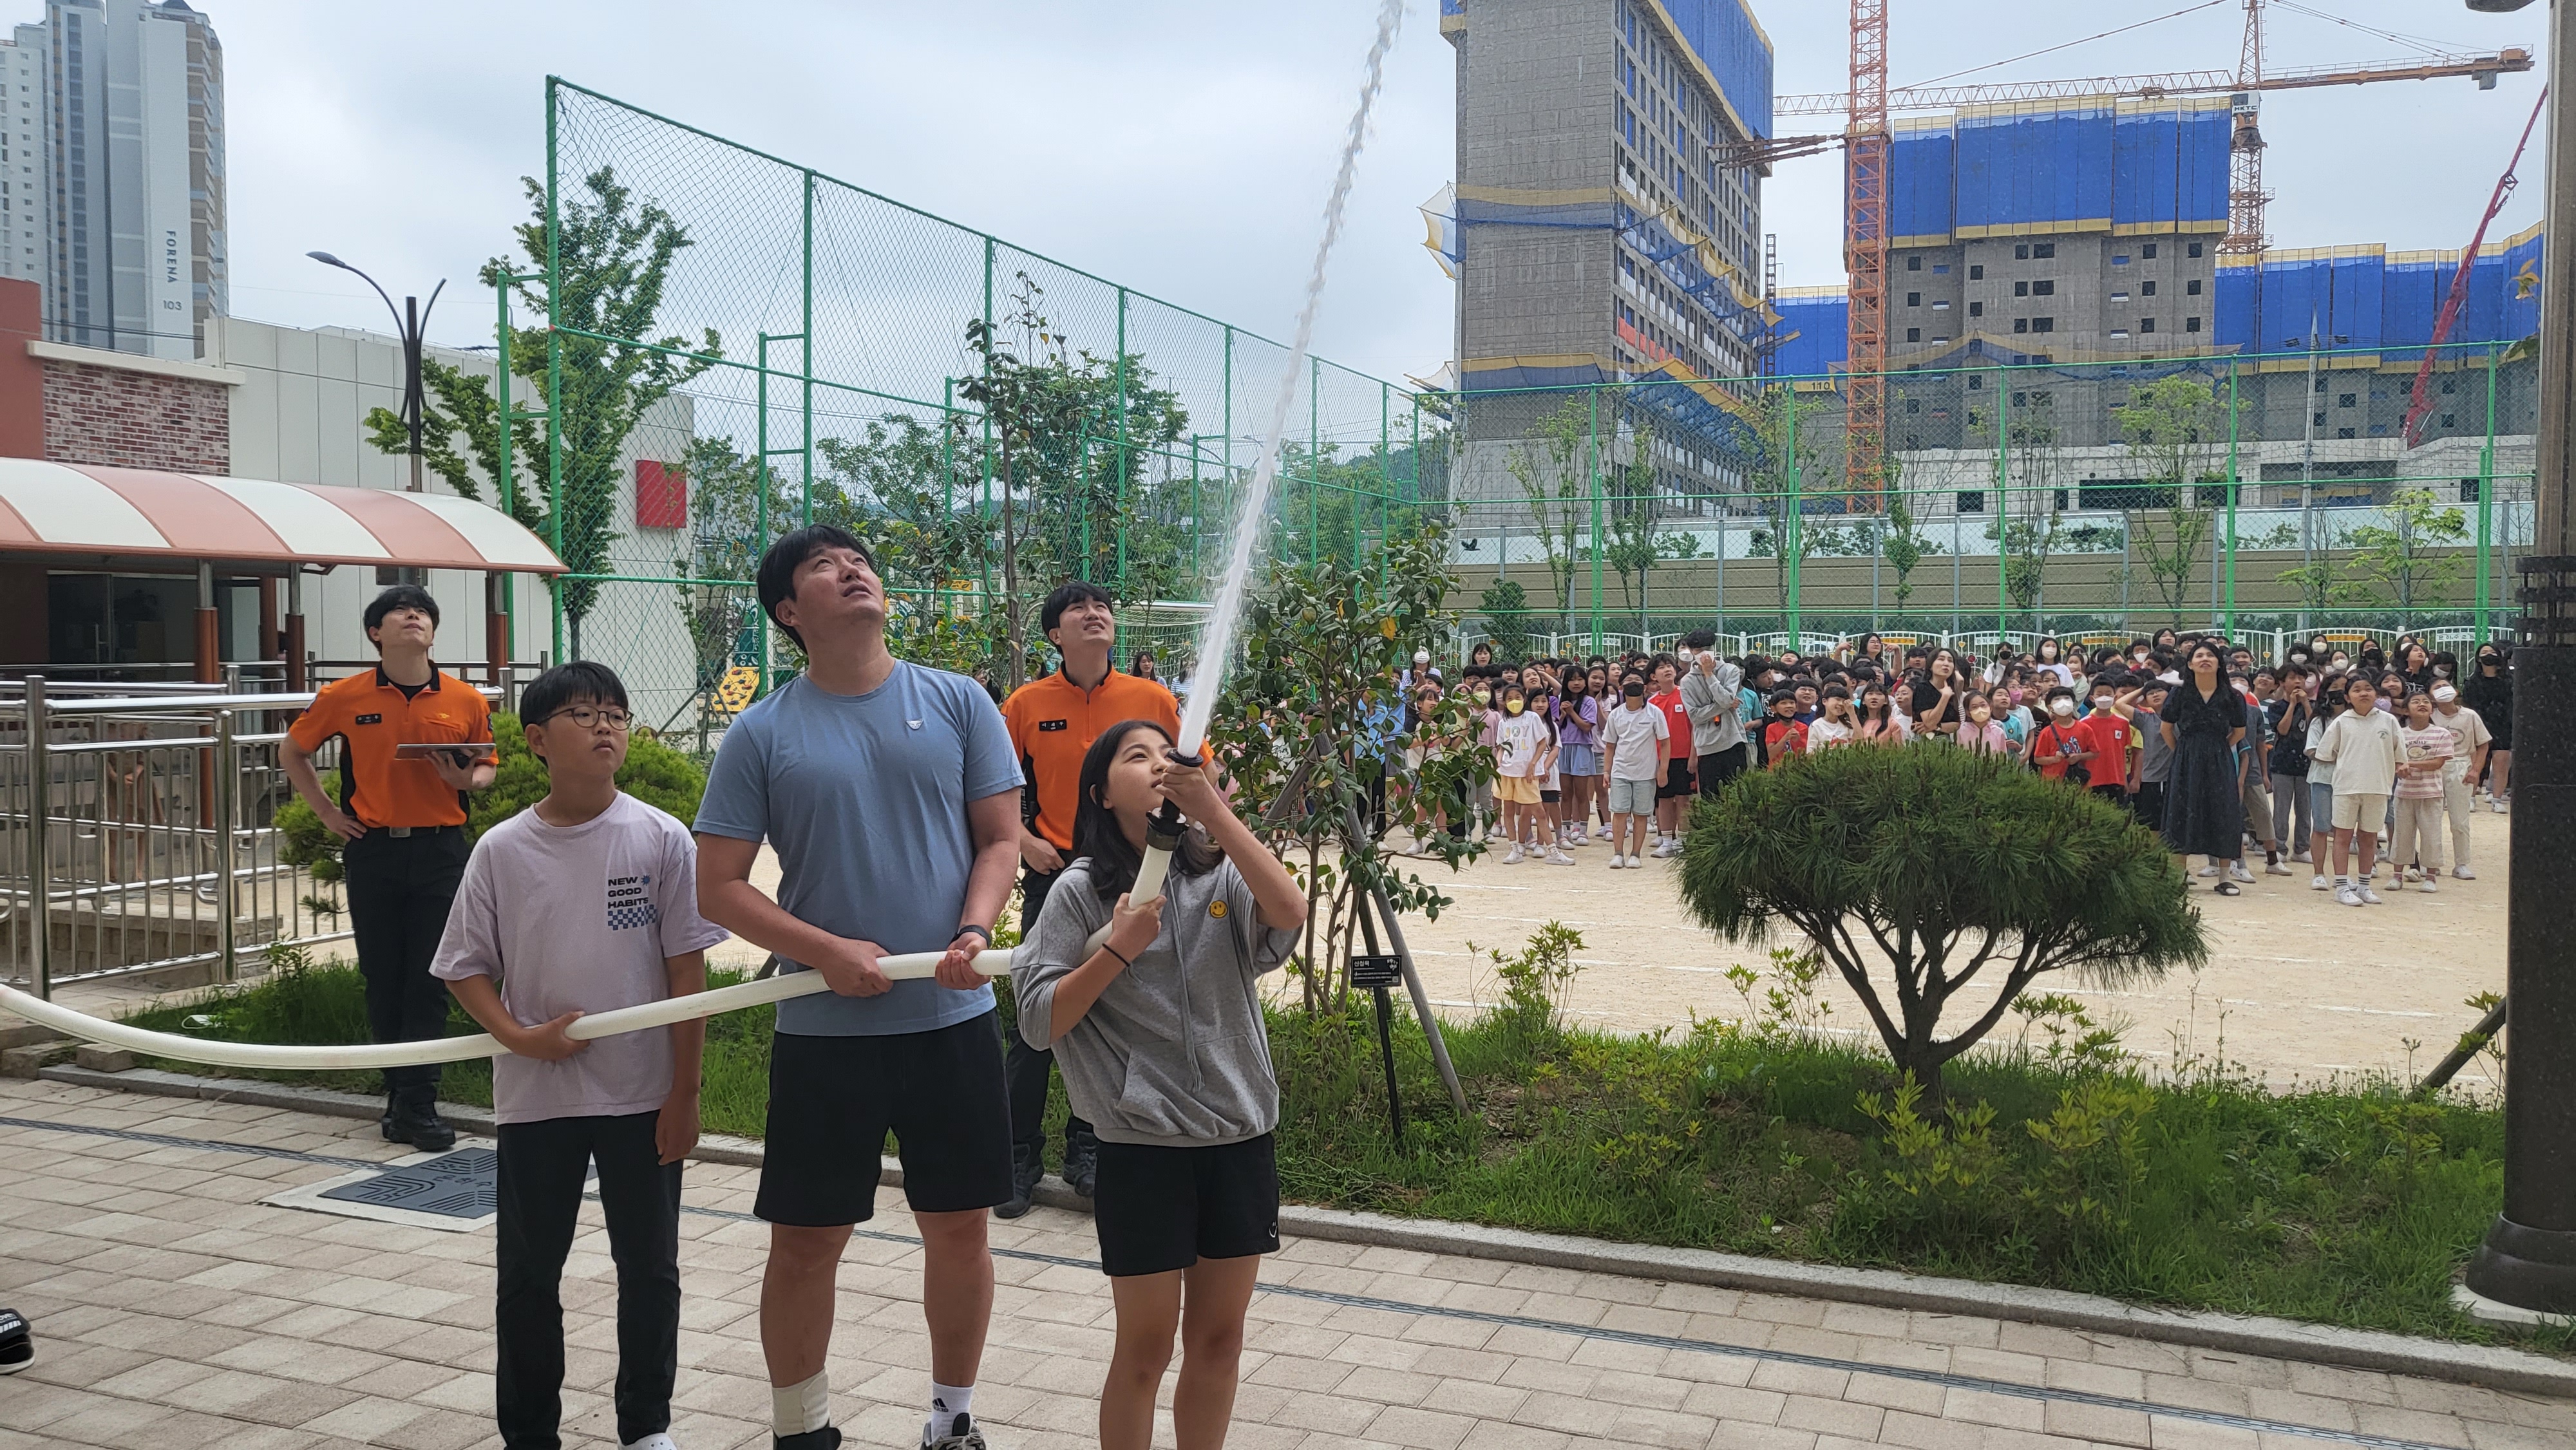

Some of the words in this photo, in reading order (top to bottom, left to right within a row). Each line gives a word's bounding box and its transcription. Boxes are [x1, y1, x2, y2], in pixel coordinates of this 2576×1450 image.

[166, 231, 177, 283] FORENA
[163, 300, 182, 310] 103
[1812, 381, 1830, 390] 110
[608, 876, 638, 887] NEW
[607, 887, 642, 897] GOOD
[607, 897, 649, 909] HABITS
[432, 1174, 496, 1189] 은하수
